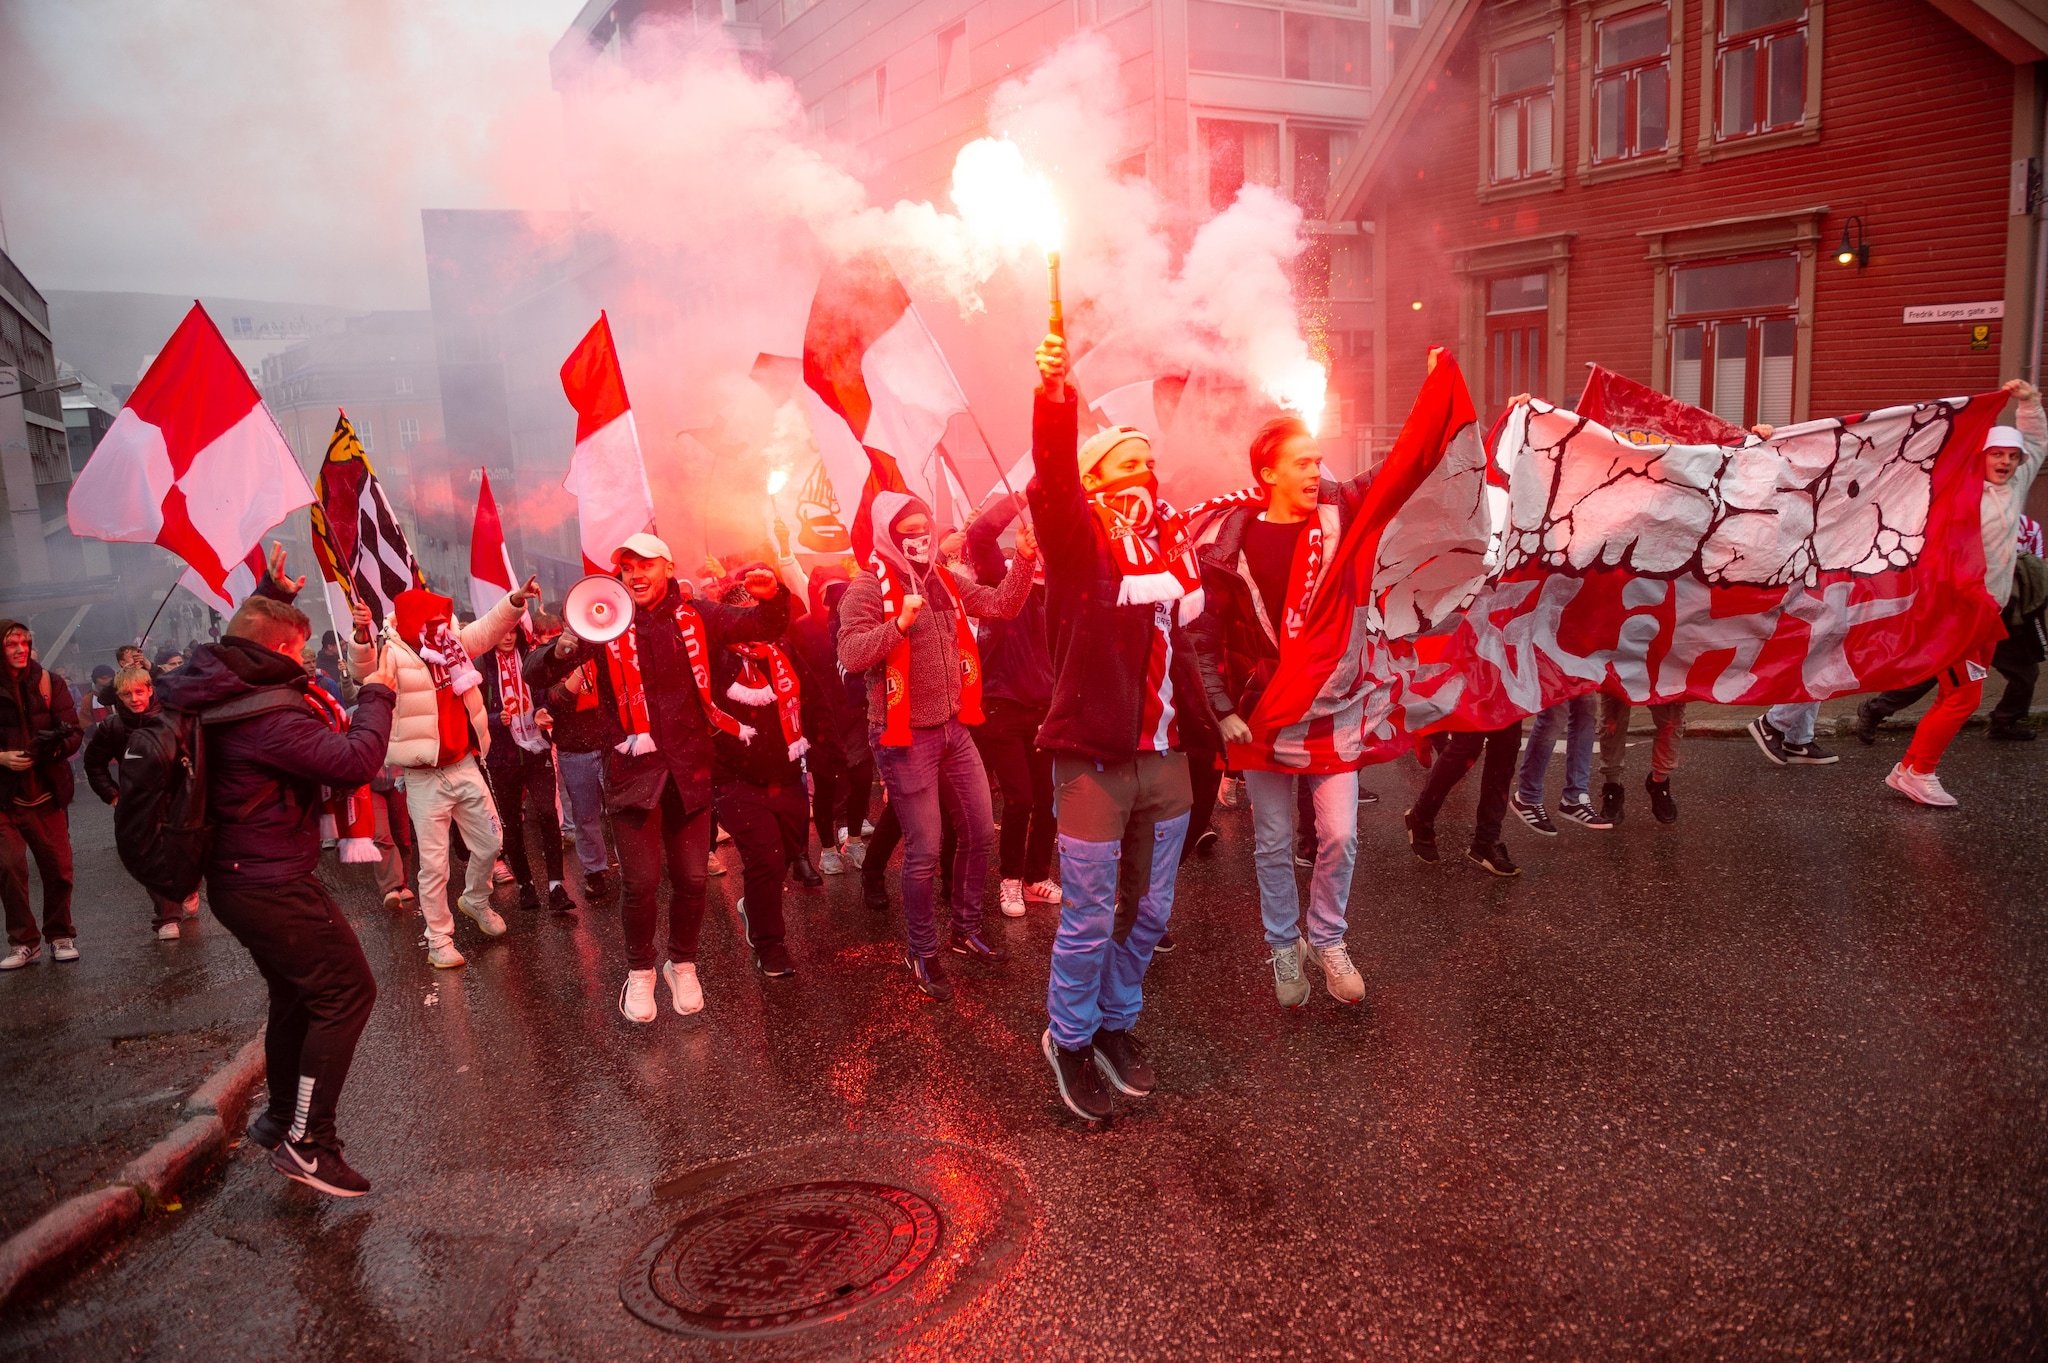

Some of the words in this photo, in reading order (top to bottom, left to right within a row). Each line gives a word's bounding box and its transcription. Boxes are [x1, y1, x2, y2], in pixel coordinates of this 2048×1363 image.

[1909, 310, 1934, 318] Fredrik
[1937, 309, 1964, 318] Langes
[1967, 307, 1985, 317] gate
[1989, 306, 1999, 314] 30
